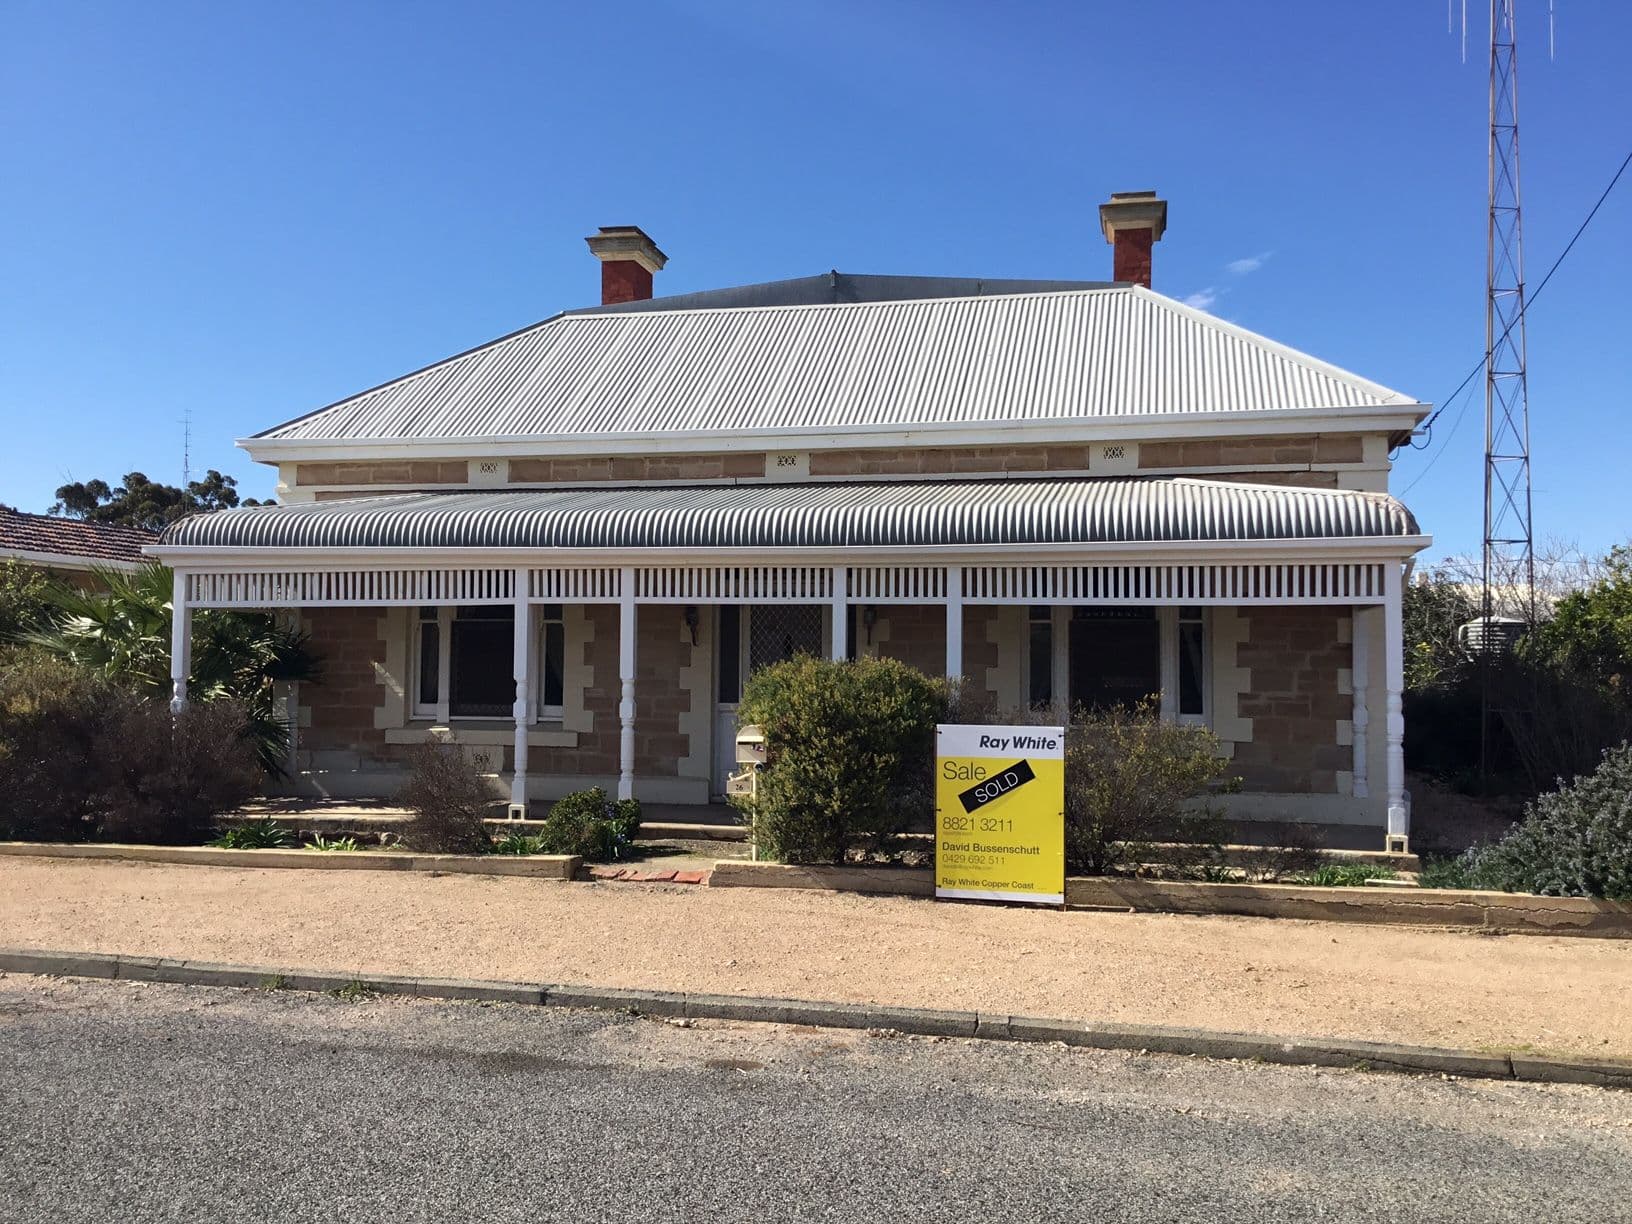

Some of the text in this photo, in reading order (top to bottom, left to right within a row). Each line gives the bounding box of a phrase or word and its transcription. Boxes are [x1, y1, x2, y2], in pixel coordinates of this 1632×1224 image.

[979, 735, 1057, 751] Ray White
[943, 761, 987, 781] Sale
[975, 772, 1018, 802] SOLD
[942, 816, 1012, 832] 8821 3211
[942, 842, 1040, 855] David Bussenschutt
[942, 854, 1005, 865] 0429 692 511
[942, 877, 1034, 889] Ray White Copper Coast
